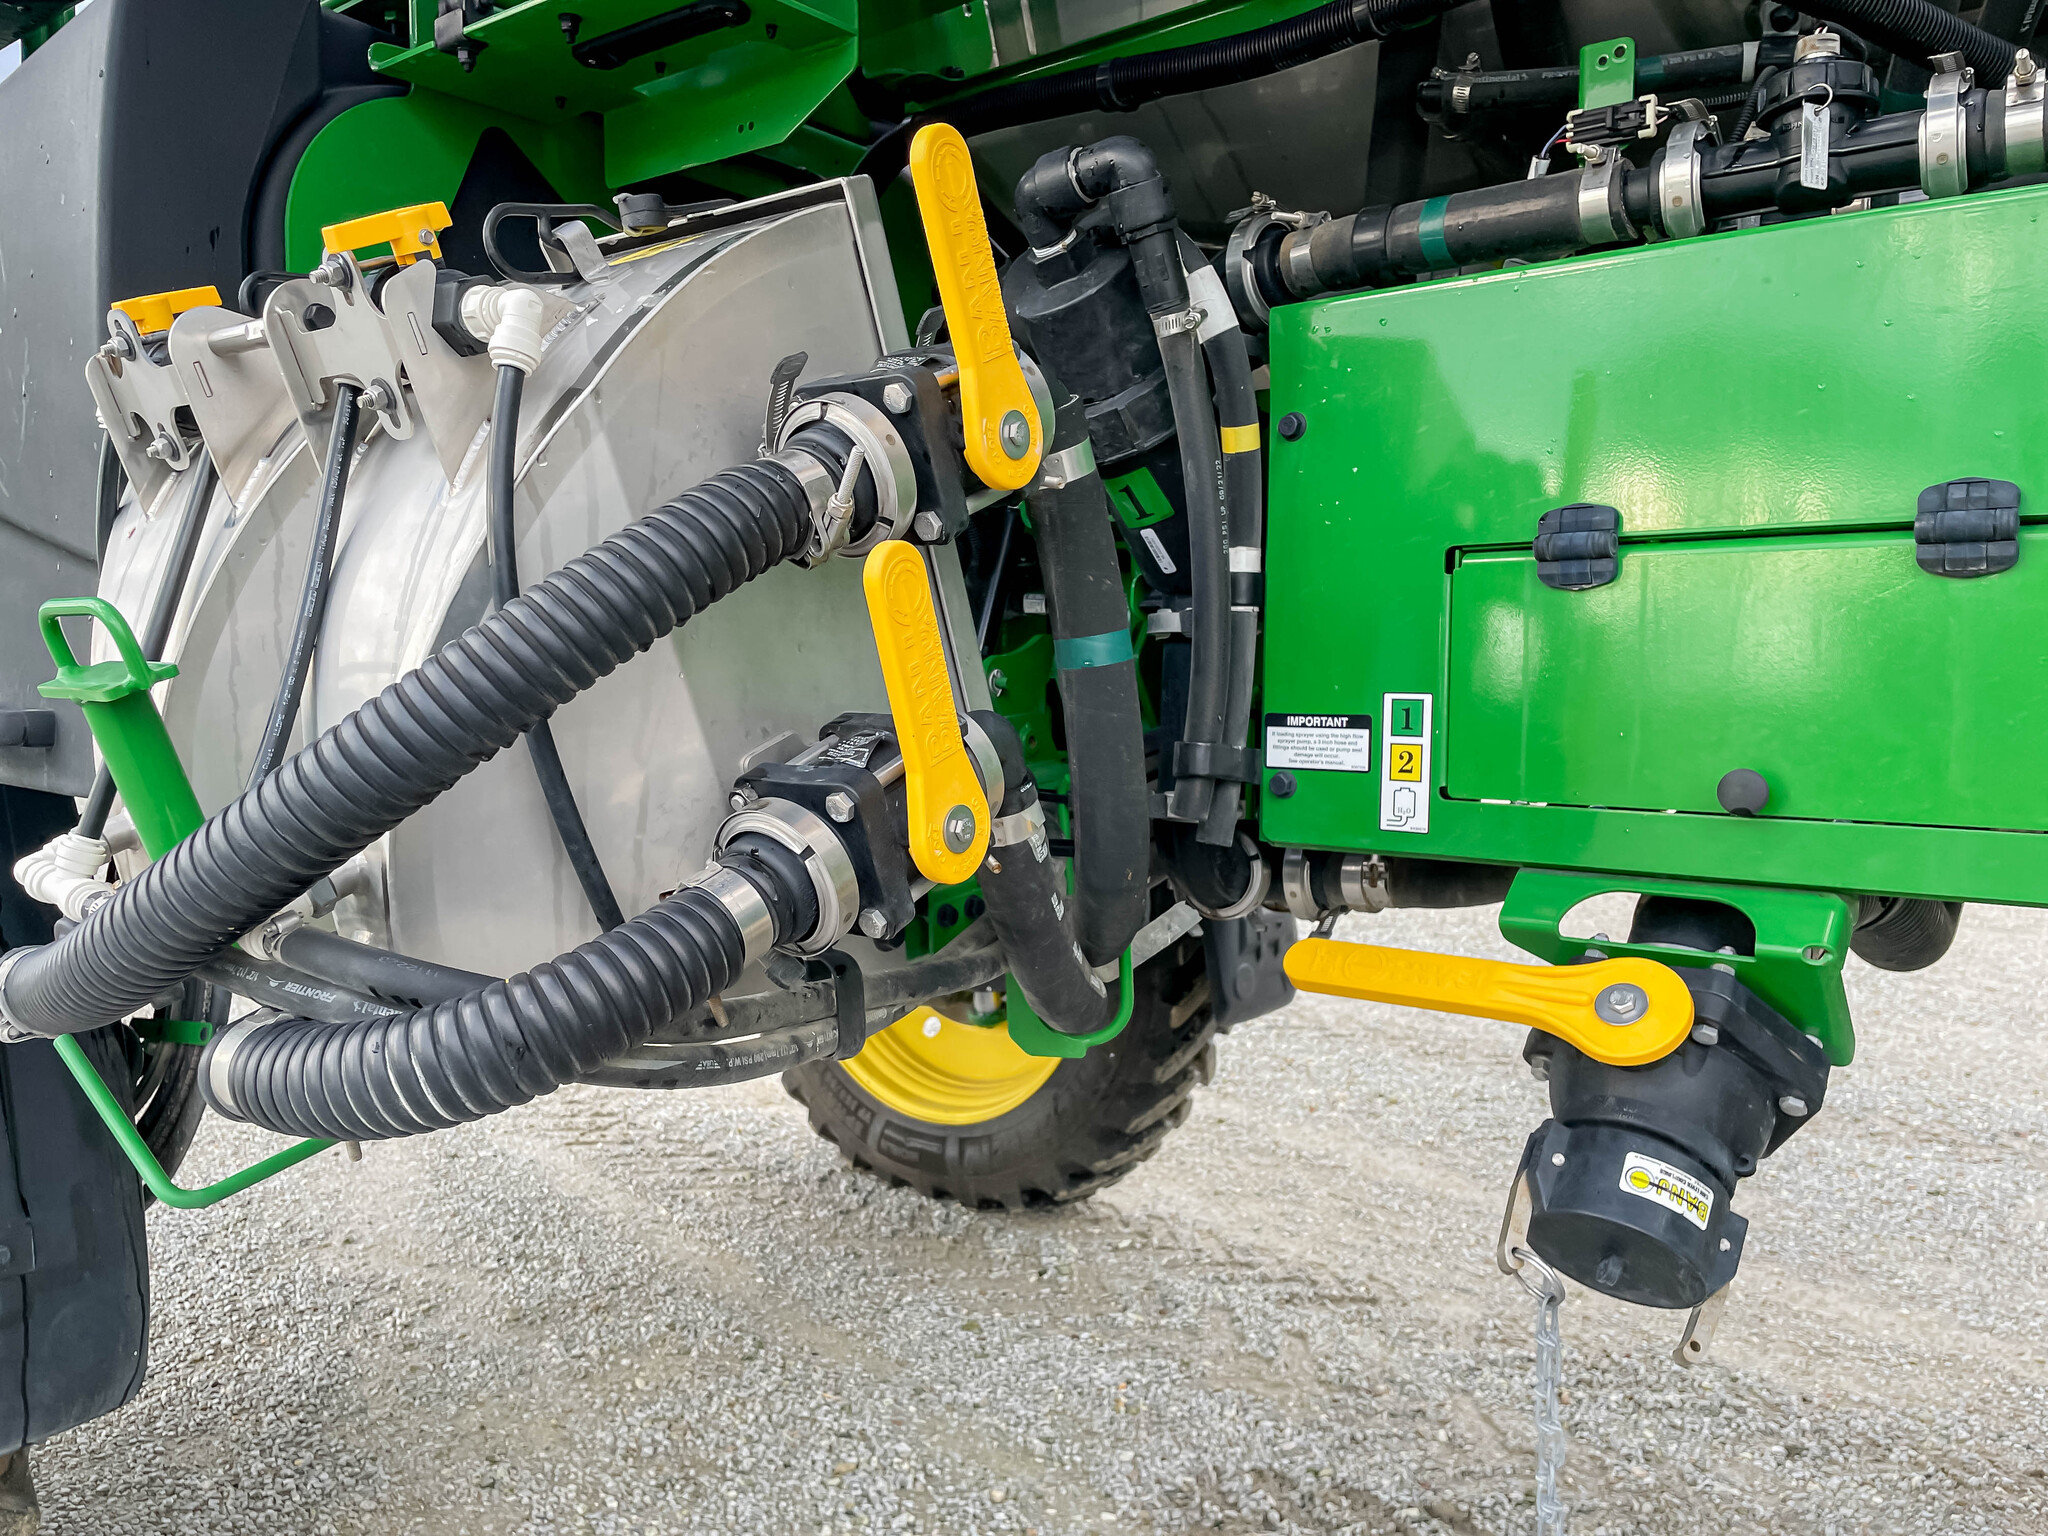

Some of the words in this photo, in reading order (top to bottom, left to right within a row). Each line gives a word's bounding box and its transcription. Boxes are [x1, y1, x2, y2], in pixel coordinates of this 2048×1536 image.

[1118, 484, 1155, 521] 1
[1287, 716, 1349, 728] IMPORTANT
[1401, 706, 1413, 730] 1
[1398, 751, 1414, 774] 2
[282, 981, 338, 1003] FRONTIER
